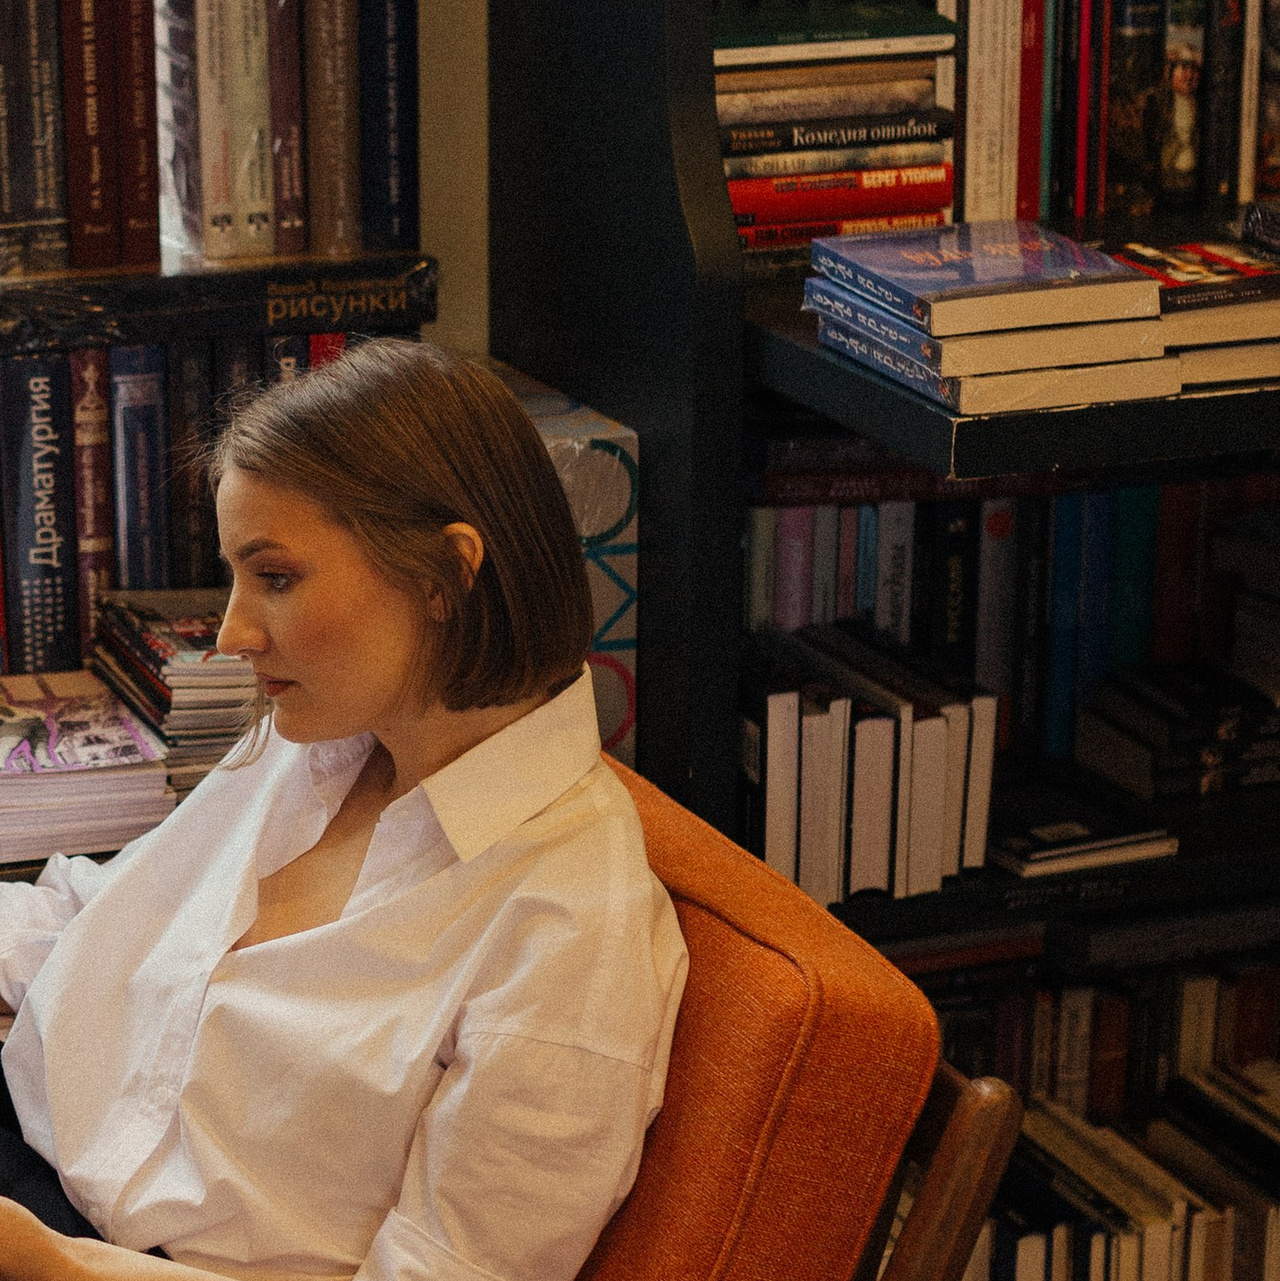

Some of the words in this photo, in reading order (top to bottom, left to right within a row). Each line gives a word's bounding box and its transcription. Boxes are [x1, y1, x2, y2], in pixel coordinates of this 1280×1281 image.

[792, 125, 868, 147] Комедия
[870, 118, 938, 142] ошибок
[862, 170, 899, 188] БЕРЕГ
[901, 167, 946, 185] УТОПИИ
[267, 290, 407, 326] рисунки
[28, 376, 63, 568] Драматургия
